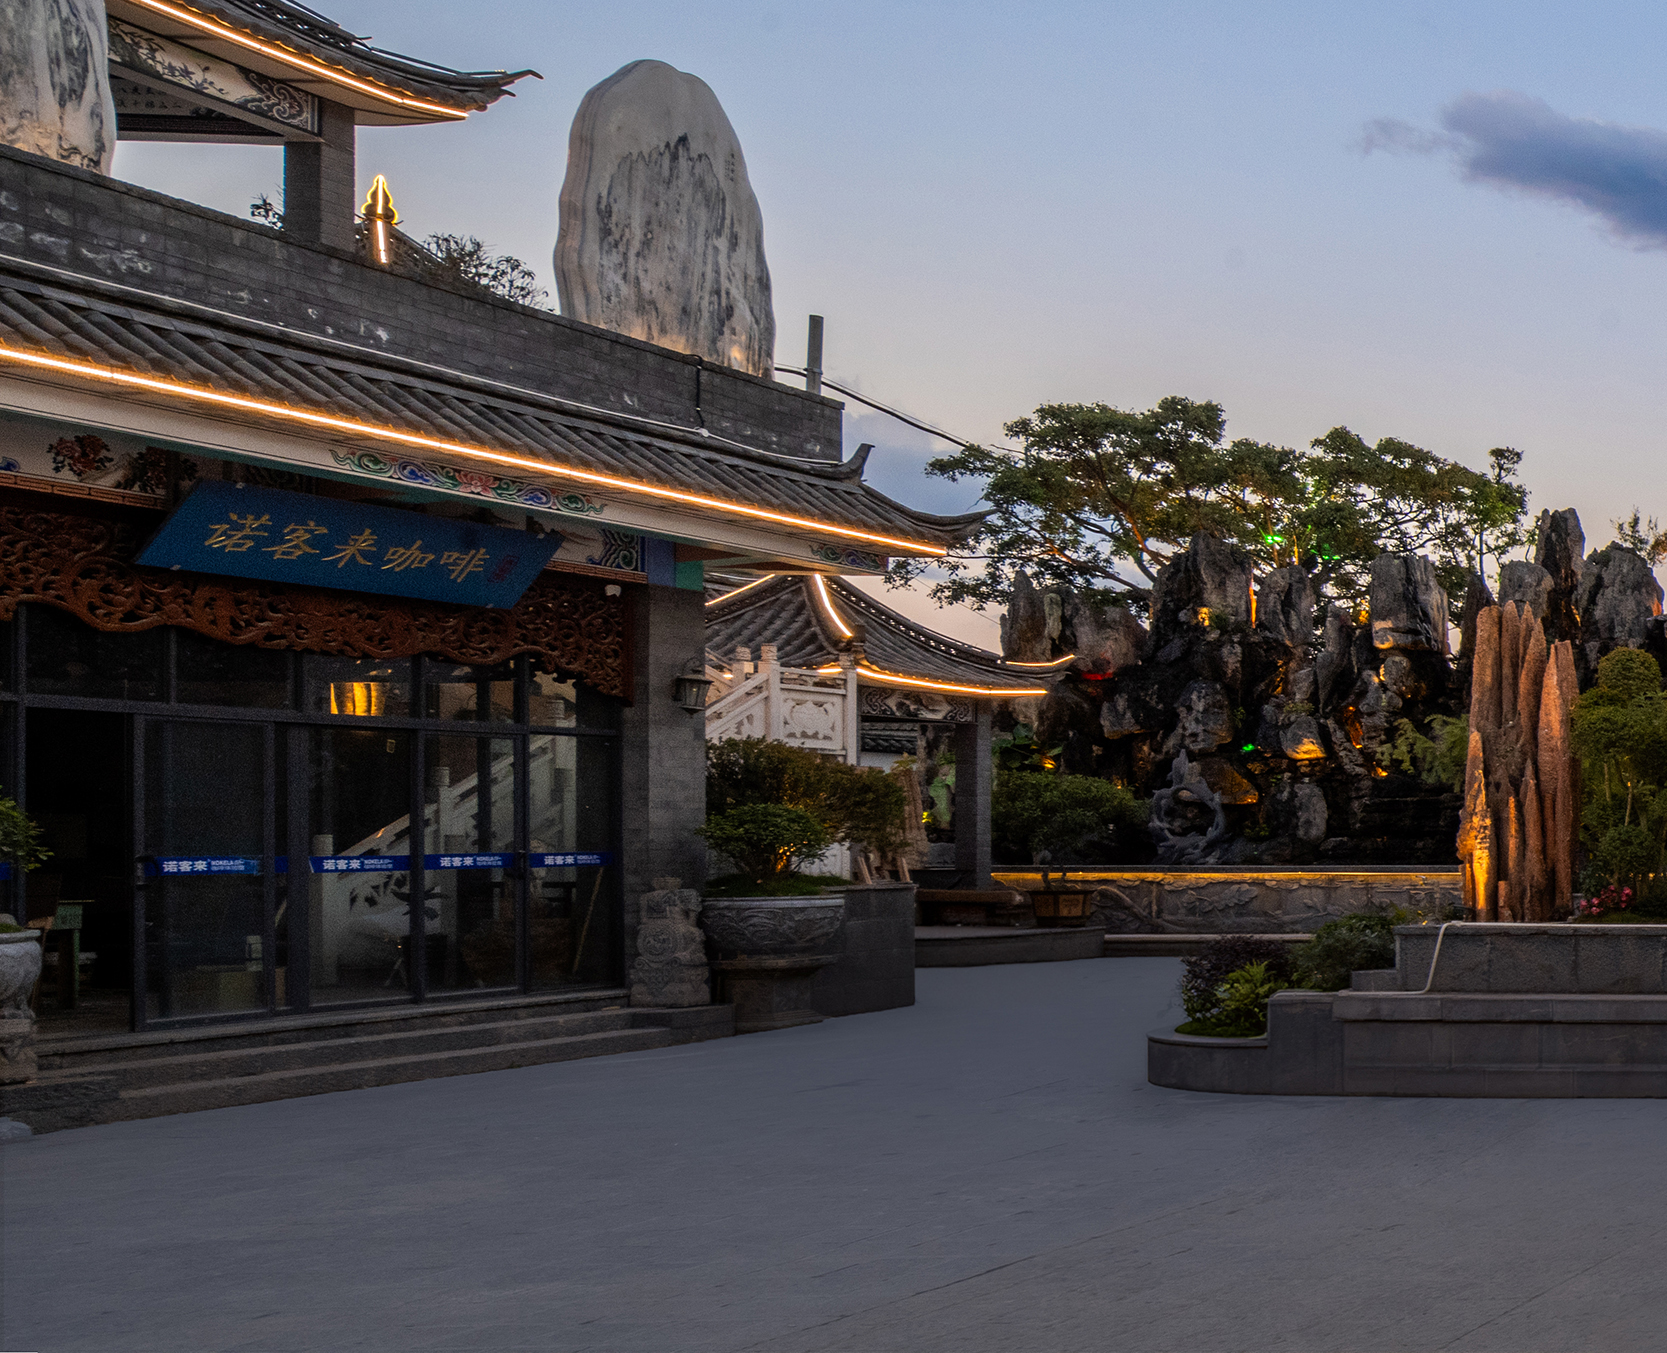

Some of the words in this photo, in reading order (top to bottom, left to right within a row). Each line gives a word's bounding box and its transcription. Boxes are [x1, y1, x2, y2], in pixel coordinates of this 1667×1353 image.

[204, 512, 490, 583] 诺客来咖啡
[322, 859, 361, 870] 诺客来
[440, 857, 474, 867] 诺客来
[544, 855, 575, 865] 诺客来
[162, 860, 208, 872] 诺客来
